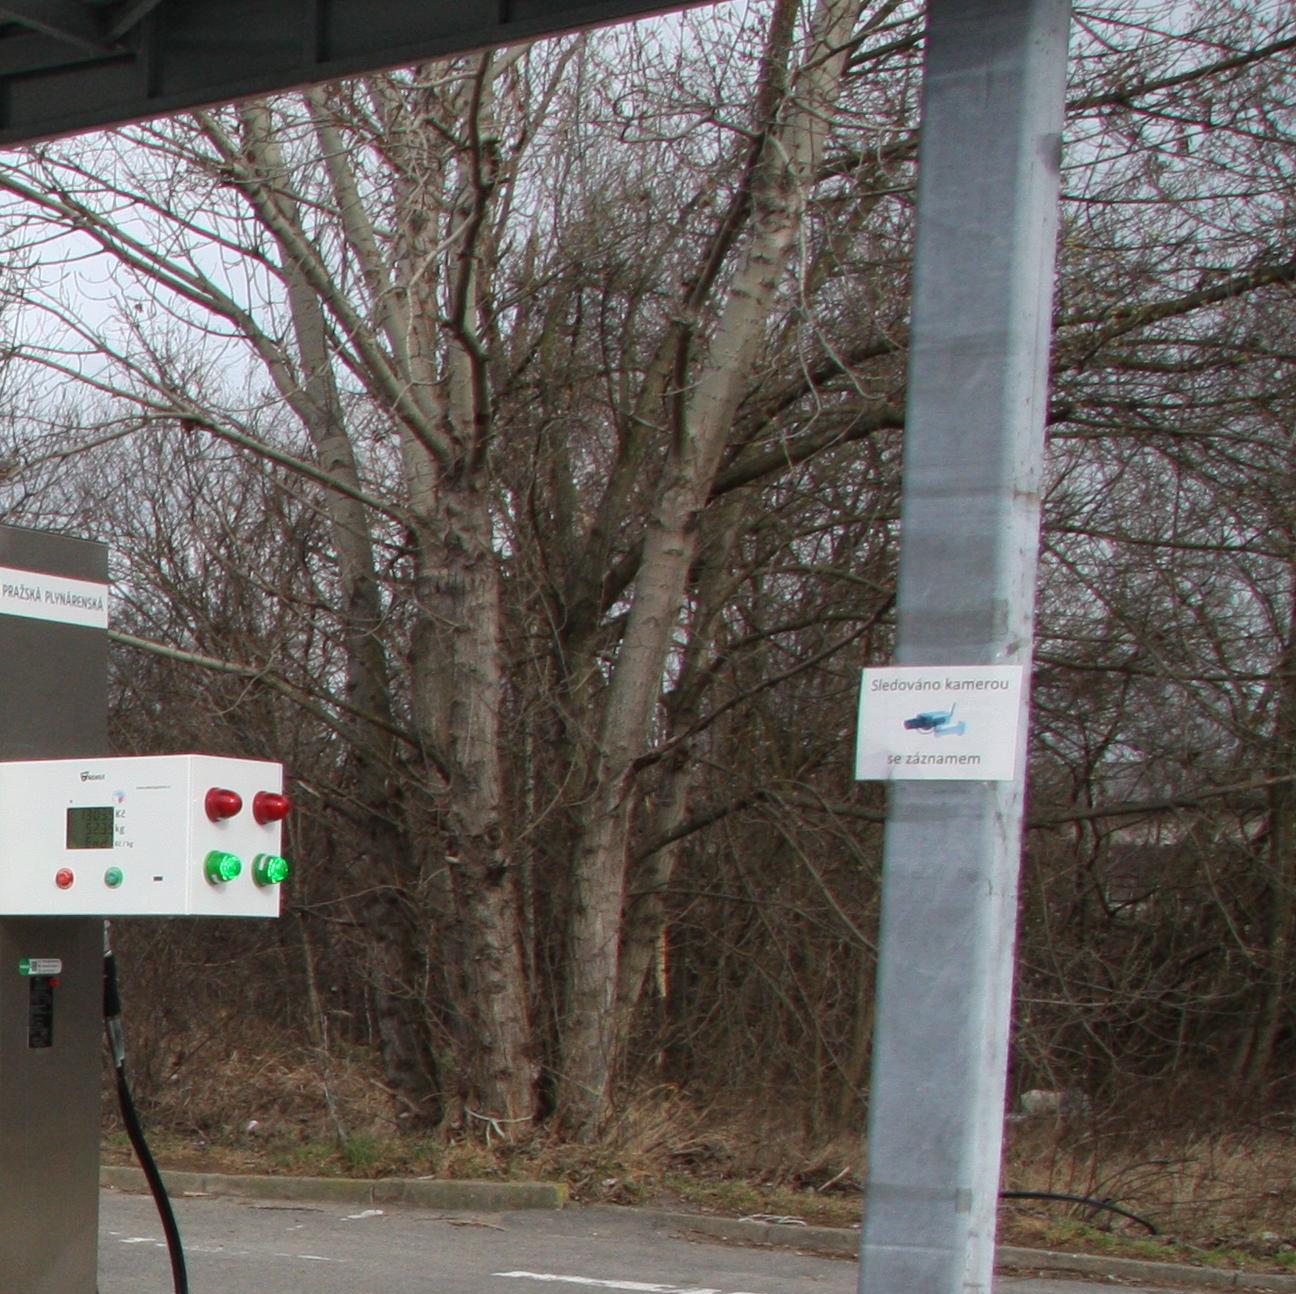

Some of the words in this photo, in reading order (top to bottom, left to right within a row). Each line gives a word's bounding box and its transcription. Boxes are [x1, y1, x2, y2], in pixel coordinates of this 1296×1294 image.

[2, 584, 42, 600] PRAŽSKÁ
[44, 590, 105, 612] PLYNÁRENSKÁ
[871, 678, 941, 692] Sledováno
[945, 678, 1009, 691] kamerou
[887, 753, 901, 765] se
[905, 752, 981, 765] záznamem
